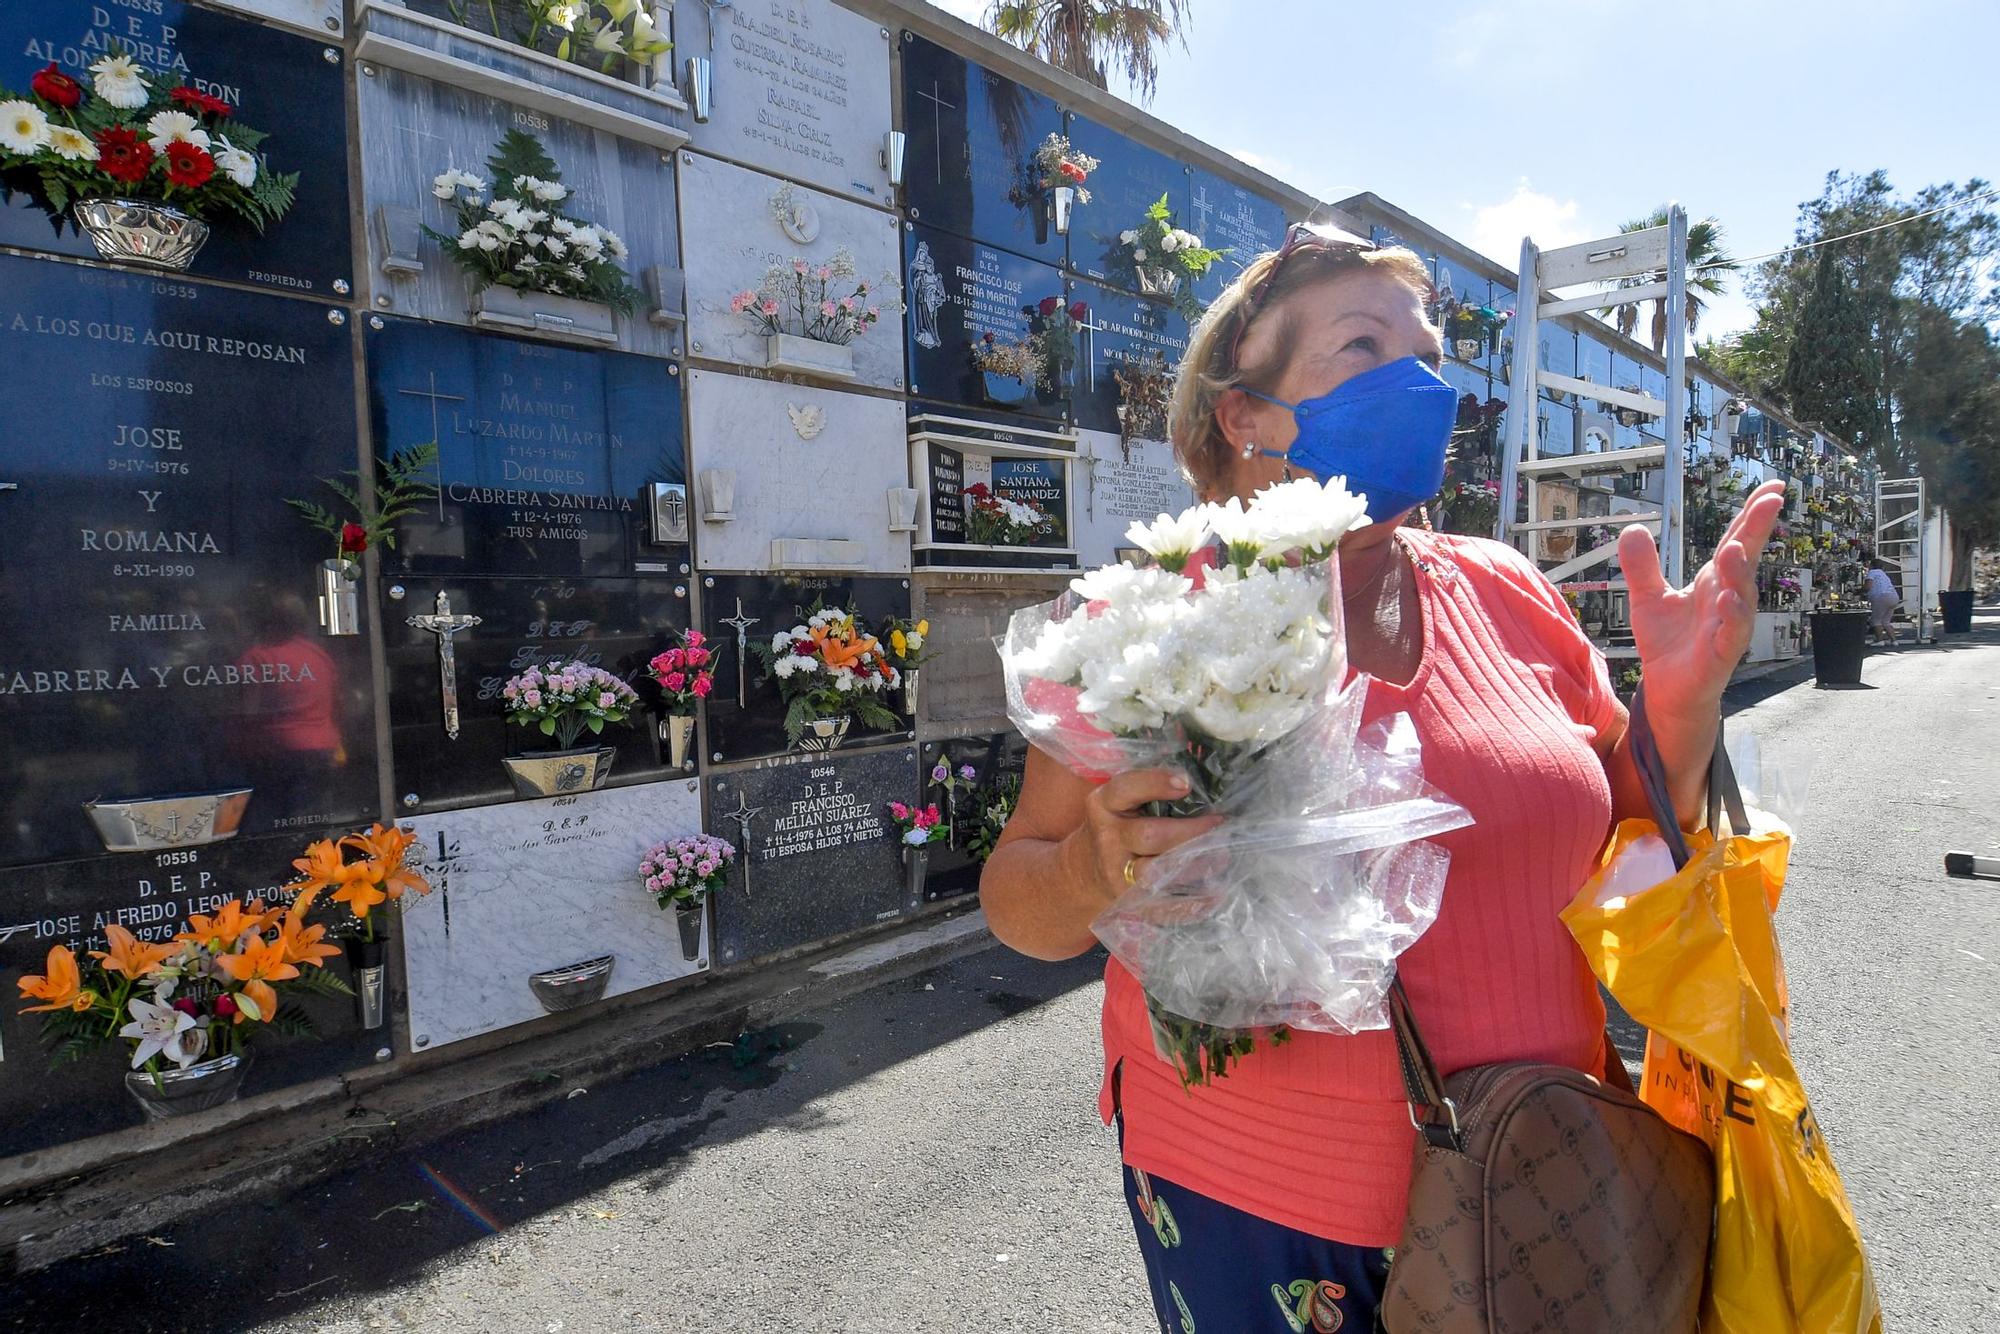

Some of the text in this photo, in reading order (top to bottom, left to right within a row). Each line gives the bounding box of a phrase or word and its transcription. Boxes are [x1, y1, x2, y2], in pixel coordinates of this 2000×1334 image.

[80, 29, 190, 73] ANDREA
[513, 111, 549, 131] 10538
[248, 270, 313, 290] PROPIEDAD
[955, 266, 1002, 288] FRANCISCO
[963, 283, 985, 298] PEÑA
[963, 320, 984, 332] ENTRE
[964, 309, 991, 323] SIEMPRE
[10, 313, 306, 365] A LOS QUE AQUI REPOSAN
[1098, 318, 1121, 333] PILAR
[1121, 324, 1160, 344] RODRIGUEZ
[1160, 335, 1187, 350] BATISTA
[91, 372, 194, 395] LOS ESPOSOS
[112, 425, 183, 451] JOSE
[108, 457, 190, 476] 9-IV-1976
[502, 459, 585, 486] DOLORES
[1012, 463, 1041, 473] JOSE
[1000, 476, 1051, 487] SANTANA
[138, 490, 162, 512] Y
[448, 480, 543, 507] CABRERA
[524, 511, 583, 525] 12-4-1976
[81, 529, 222, 554] ROMANA
[539, 527, 589, 541] AMIGOS
[113, 563, 196, 578] 8-XI-1990
[108, 614, 206, 633] FAMILIA
[150, 666, 174, 689] Y
[182, 662, 317, 688] CABRERA
[810, 766, 836, 779] 10546
[791, 793, 856, 815] FRANCISCO
[774, 803, 872, 832] MELIAN SUAREZ
[775, 817, 879, 846] 11-4-1976 A LOS 74 AÑOS
[762, 827, 884, 860] TU ESPOSA HIJOS Y NIETOS
[154, 850, 198, 869] 10536
[138, 871, 218, 898] D. E. P.
[34, 915, 81, 939] JOSE
[92, 901, 178, 930] ALFREDO
